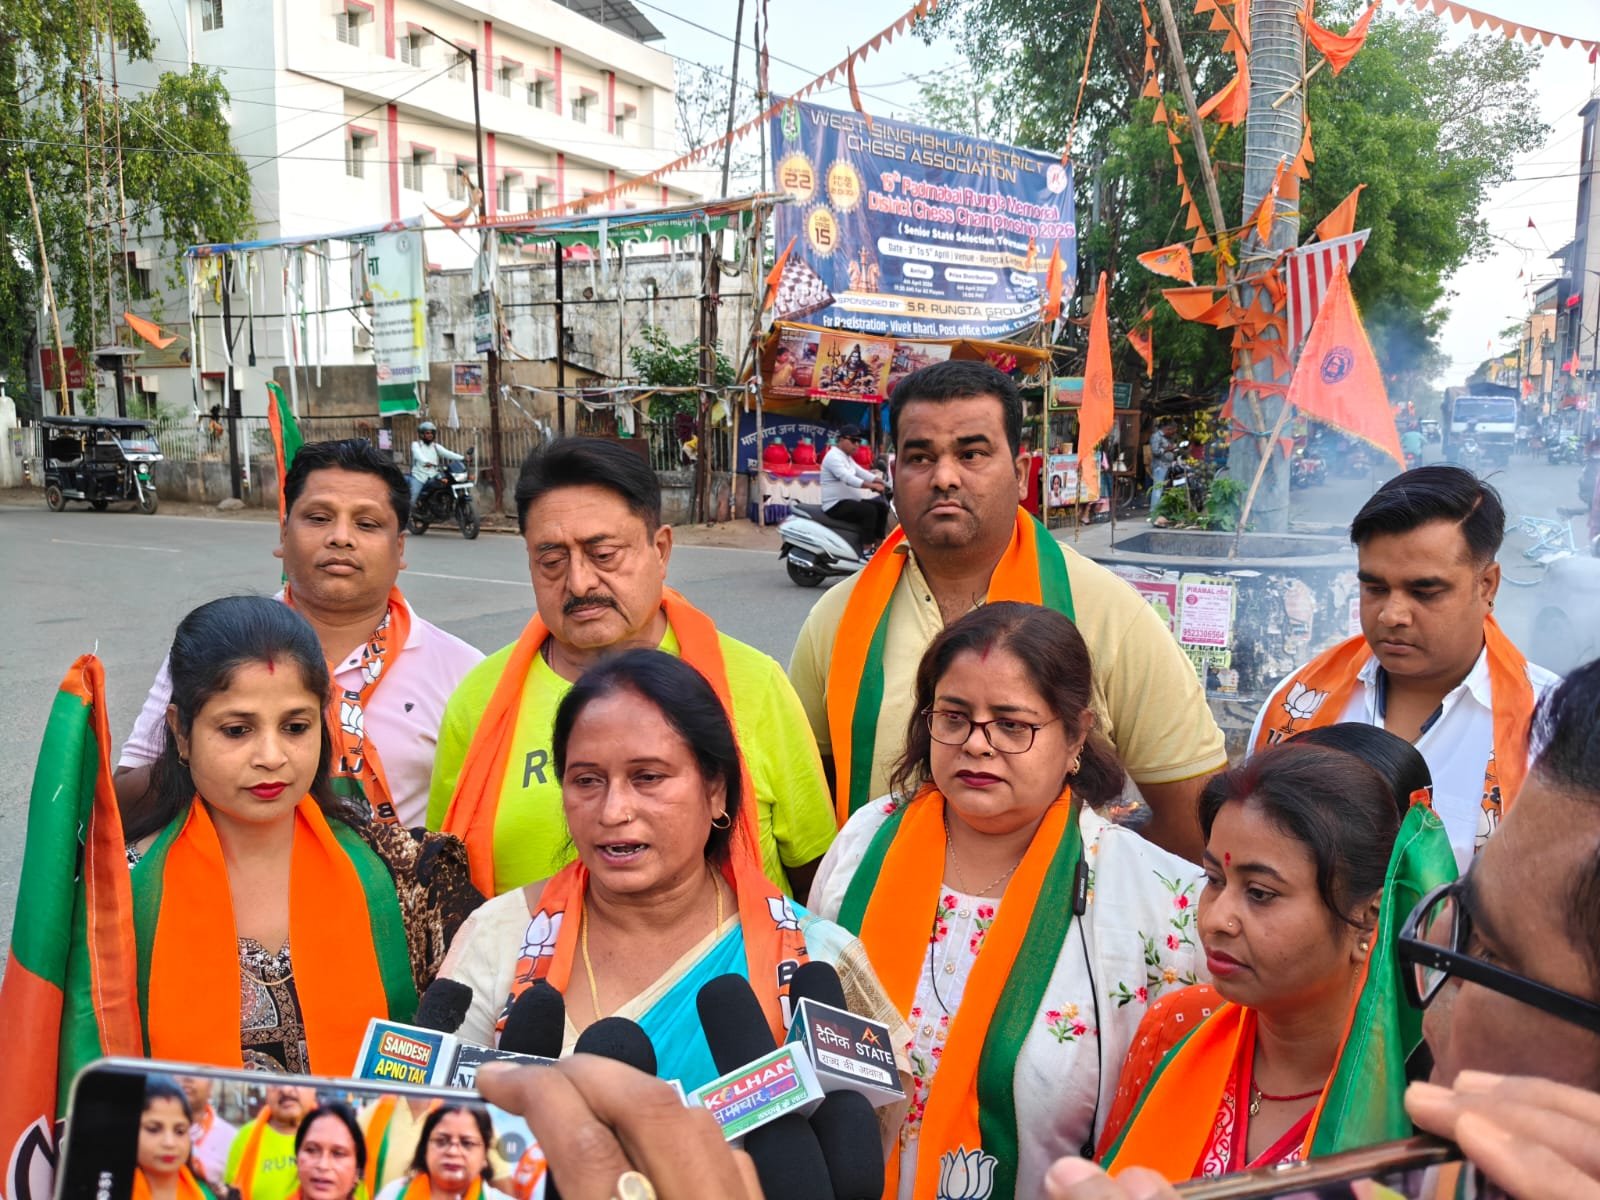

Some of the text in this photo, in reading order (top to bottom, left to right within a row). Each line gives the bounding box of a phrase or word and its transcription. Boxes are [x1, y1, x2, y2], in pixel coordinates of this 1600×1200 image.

[810, 109, 1045, 174] WEST SINGHBHUM DISTRICT
[847, 134, 906, 161] CHESS
[911, 148, 1017, 184] ASSOCIATION
[785, 172, 812, 190] 22
[868, 190, 912, 217] District
[912, 199, 954, 223] Chess
[1038, 222, 1077, 238] 2026
[814, 227, 831, 246] 15
[904, 223, 931, 237] Senior
[932, 228, 955, 241] State
[955, 231, 995, 245] Selection
[907, 301, 928, 313] S.R.
[930, 303, 983, 317] RUNGTA
[889, 319, 912, 333] Vivek
[939, 323, 957, 336] Post
[777, 424, 797, 434] जन
[815, 1023, 850, 1050] दैनिक
[384, 1036, 431, 1063] SANDESH
[855, 1042, 894, 1065] STATE
[374, 1058, 428, 1085] APNO TAK
